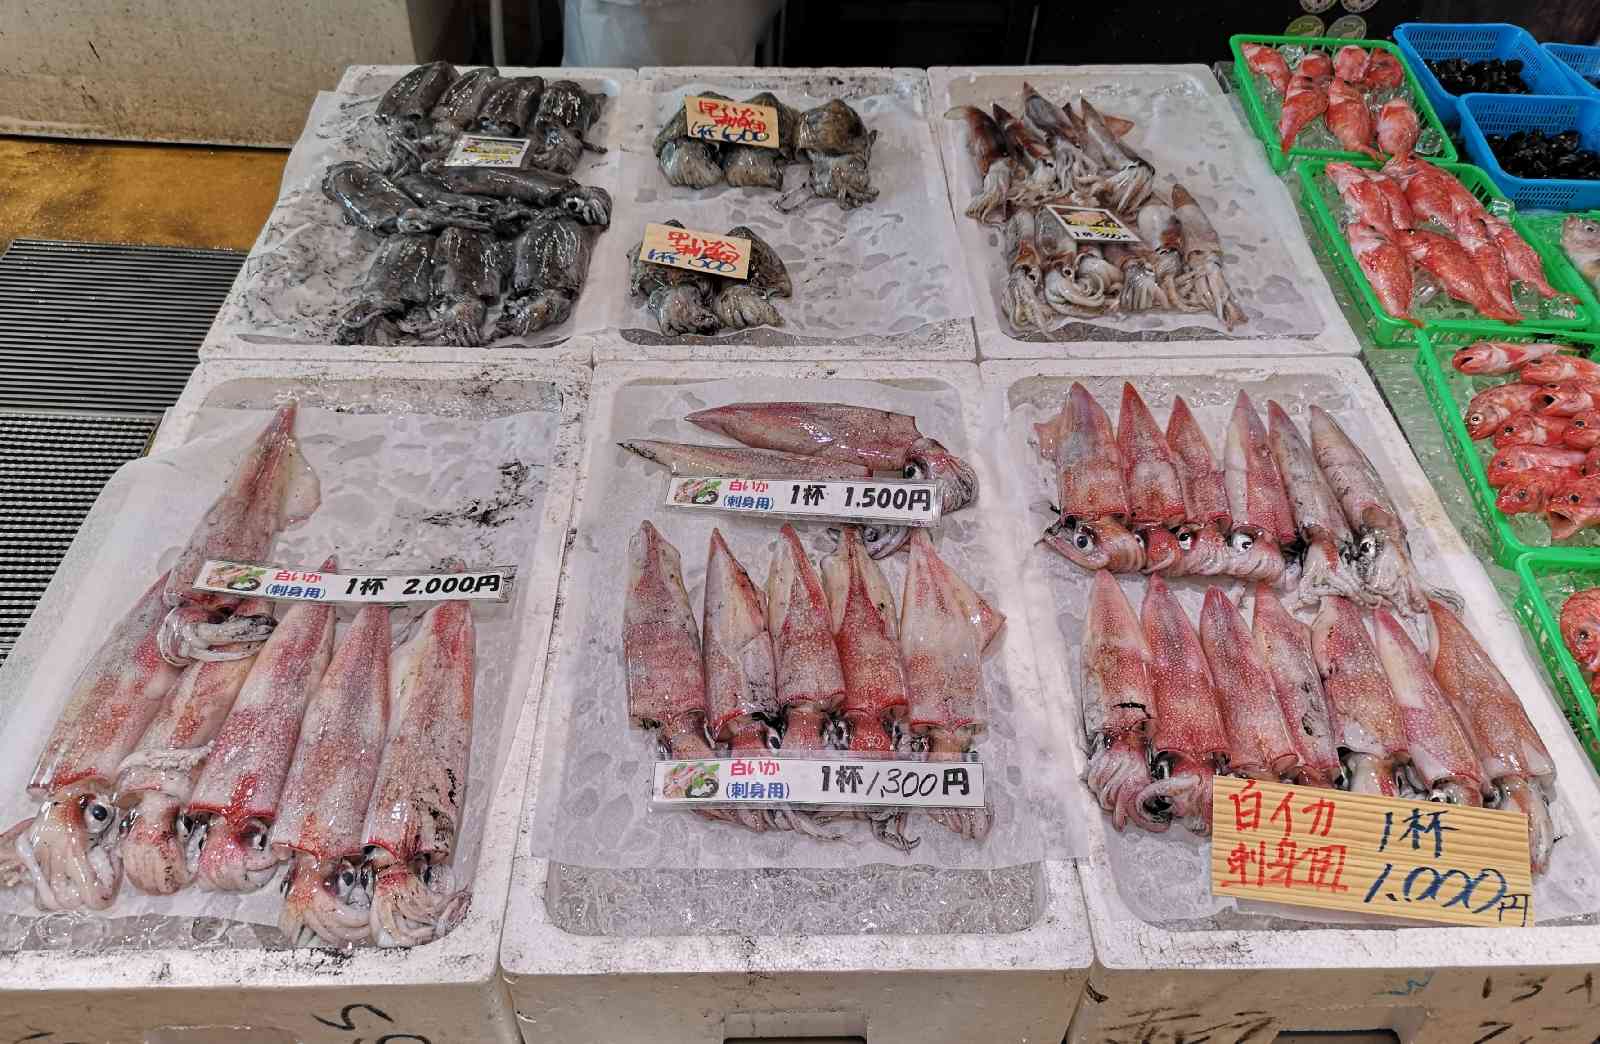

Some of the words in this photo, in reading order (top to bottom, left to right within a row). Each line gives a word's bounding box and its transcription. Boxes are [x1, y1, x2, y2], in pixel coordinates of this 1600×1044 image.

[728, 480, 769, 493] 白いか
[790, 484, 826, 506] 1杯
[723, 494, 774, 510] (刺身用)
[274, 570, 322, 583] 白いか
[265, 583, 326, 599] (刺身用)
[345, 577, 388, 595] 1杯
[730, 760, 780, 776] 白いか
[726, 781, 790, 799] (刺身用)
[1229, 780, 1336, 837] 白イカ
[1378, 808, 1459, 858] 1杯
[1220, 838, 1349, 892] 刺身用
